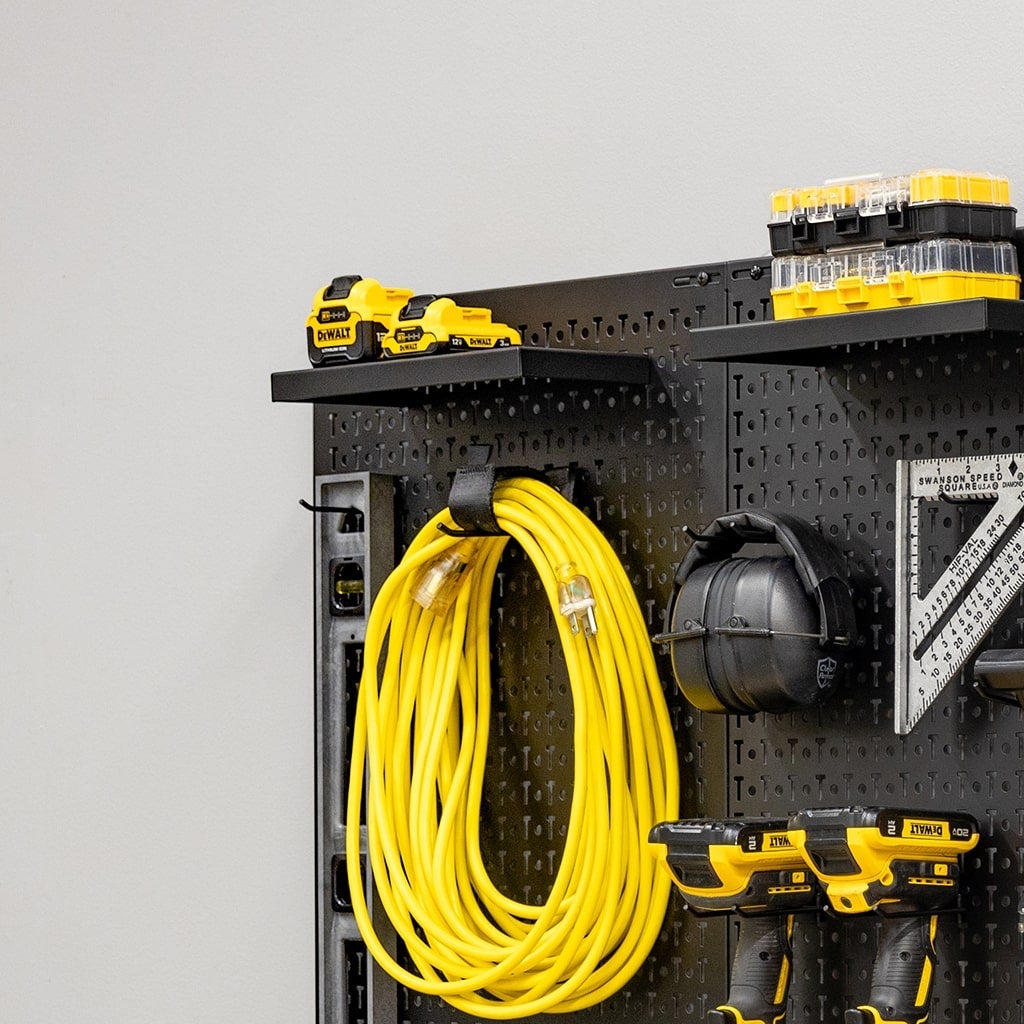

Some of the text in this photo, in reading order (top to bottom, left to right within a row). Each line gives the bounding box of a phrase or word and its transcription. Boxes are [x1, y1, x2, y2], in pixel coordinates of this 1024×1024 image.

[937, 467, 941, 475] 1
[965, 465, 971, 474] 2
[995, 463, 1001, 472] 3
[919, 472, 1003, 485] SWANSON SPEED
[938, 482, 977, 492] SQUARE
[948, 538, 979, 574] HIP-VAL
[918, 620, 925, 629] 2
[925, 612, 931, 620] 3
[931, 604, 937, 612] 4
[936, 597, 942, 605] 5
[941, 590, 948, 599] 6
[949, 579, 956, 587] 8
[956, 567, 964, 578] 10
[963, 558, 972, 570] 12
[970, 549, 979, 559] 15
[977, 539, 986, 550] 18
[987, 525, 997, 537] 24
[994, 514, 1005, 526] 30
[931, 653, 938, 662] 2
[942, 640, 948, 648] 3
[951, 628, 957, 636] 4
[959, 618, 965, 626] 5
[965, 608, 972, 617] 6
[971, 600, 977, 608] 7
[977, 593, 984, 601] 8
[986, 578, 995, 589] 10
[994, 567, 1004, 578] 12
[1004, 553, 1014, 564] 15
[1013, 543, 1022, 554] 18
[918, 687, 925, 696] 5
[931, 667, 940, 679] 10
[943, 651, 952, 663] 15
[953, 637, 963, 649] 20
[964, 623, 974, 636] 25
[973, 611, 983, 623] 30
[983, 597, 993, 610] 35
[992, 586, 1001, 598] 40
[1001, 575, 1010, 586] 45
[1009, 563, 1019, 576] 50
[910, 823, 943, 836] DEWALT
[769, 836, 792, 848] WALT
